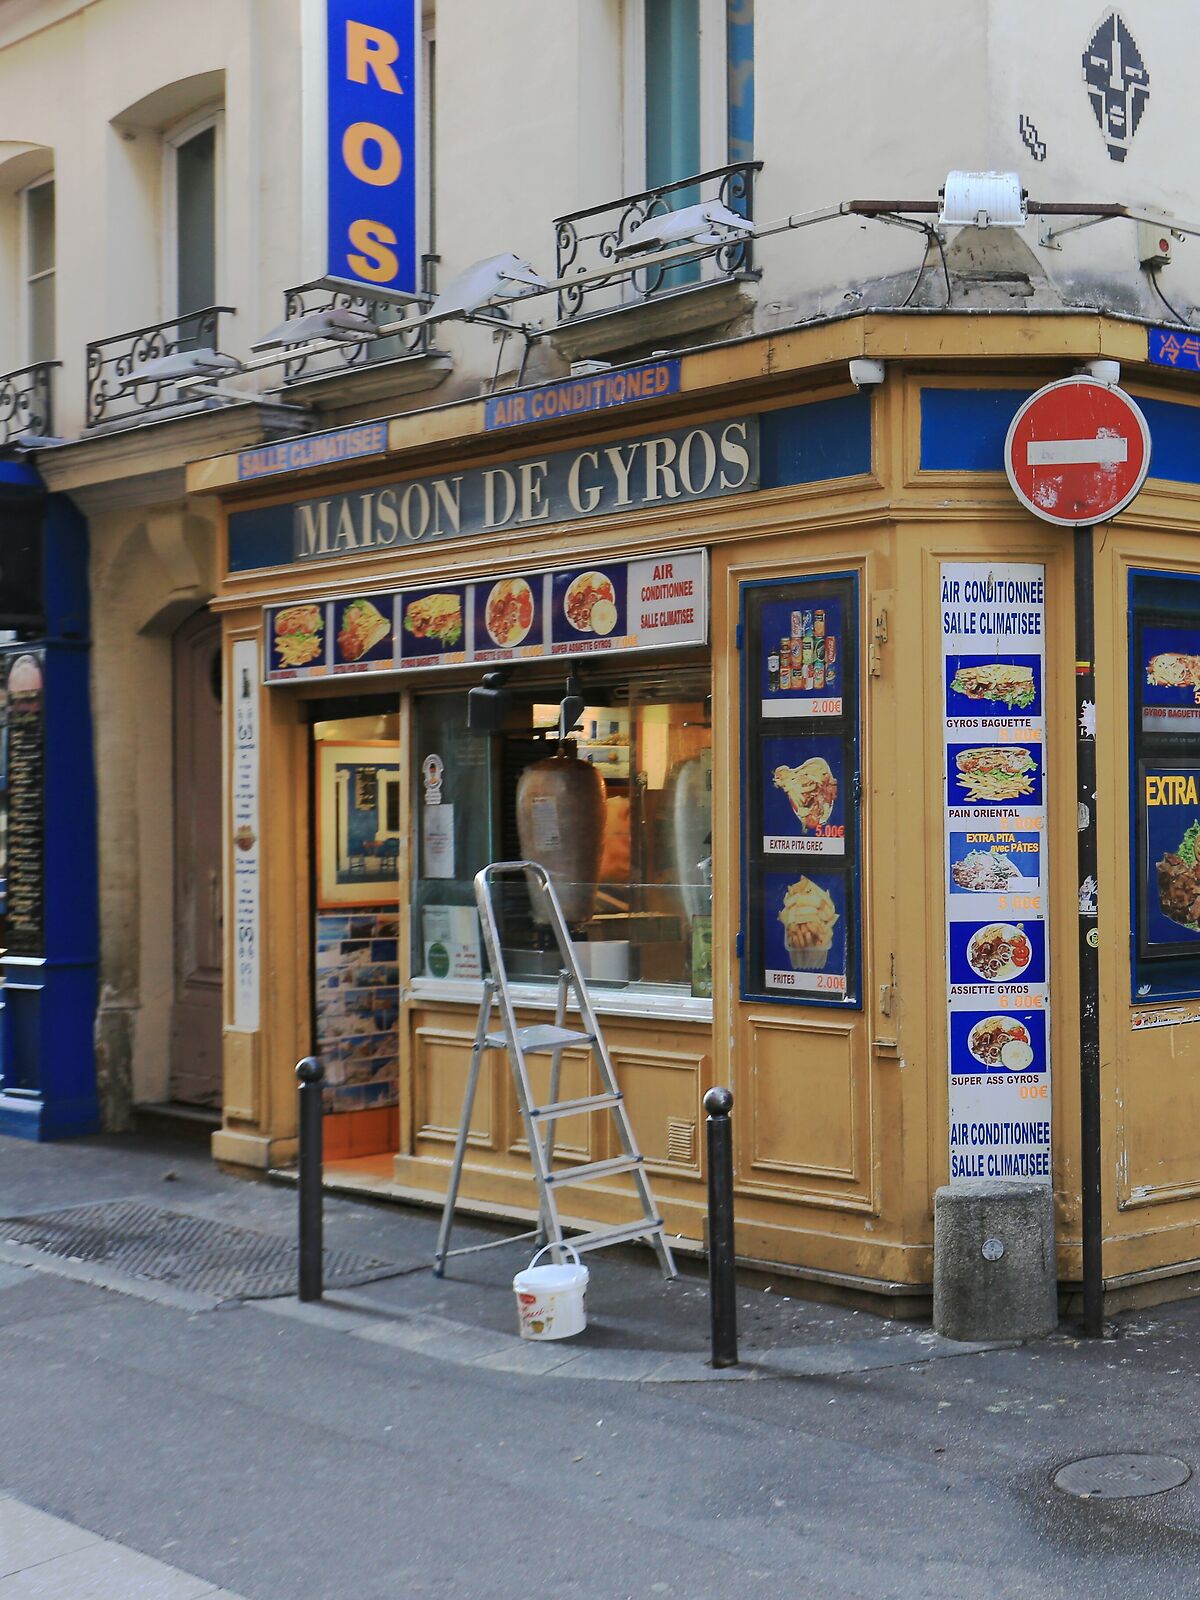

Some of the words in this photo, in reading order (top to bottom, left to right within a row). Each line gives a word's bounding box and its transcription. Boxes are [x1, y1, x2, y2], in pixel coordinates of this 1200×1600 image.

[494, 397, 525, 427] AIR
[530, 364, 670, 417] CONDITIONED
[242, 447, 287, 477] SALLE
[291, 425, 384, 467] CLIMATISEE
[298, 477, 464, 557] MAISON
[484, 461, 550, 528] DE
[568, 423, 750, 513] GYROS
[652, 563, 673, 581] AIR
[641, 580, 694, 602] CONDITIONNEE
[941, 580, 960, 603] AIR
[964, 580, 1044, 604] CONDITIONNEE
[640, 612, 659, 629] SALLE
[660, 607, 694, 627] CLIMATISEE
[943, 611, 976, 634] SALLE
[979, 612, 1041, 635] CLIMATISEE
[812, 700, 841, 713] 2.00€
[1143, 708, 1167, 718] GYROS
[946, 719, 979, 728] GYROS
[981, 718, 1032, 728] BAGUETTE
[1146, 775, 1198, 806] EXTRA
[948, 809, 971, 818] PAIN
[973, 808, 1019, 818] ORIENTAL
[815, 824, 845, 838] 5.00€
[966, 833, 994, 843] EXTRA
[996, 833, 1016, 843] PITA
[769, 838, 790, 850] EXTRA
[791, 839, 806, 851] PITA
[806, 839, 824, 851] GREC
[990, 844, 1010, 853] avec
[1010, 841, 1039, 853] PÂTES
[773, 973, 795, 985] FRITES
[816, 975, 845, 990] 2.00€
[950, 985, 995, 995] ASSIETTE
[997, 984, 1029, 995] GYROS
[951, 1076, 982, 1086] SUPER
[986, 1075, 1004, 1085] ASS
[1007, 1074, 1040, 1085] GYROS
[950, 1122, 969, 1146] AIR
[971, 1121, 1050, 1146] CONDITIONNEE
[951, 1154, 985, 1178] SALLE
[987, 1152, 1049, 1177] CLIMATISEE
